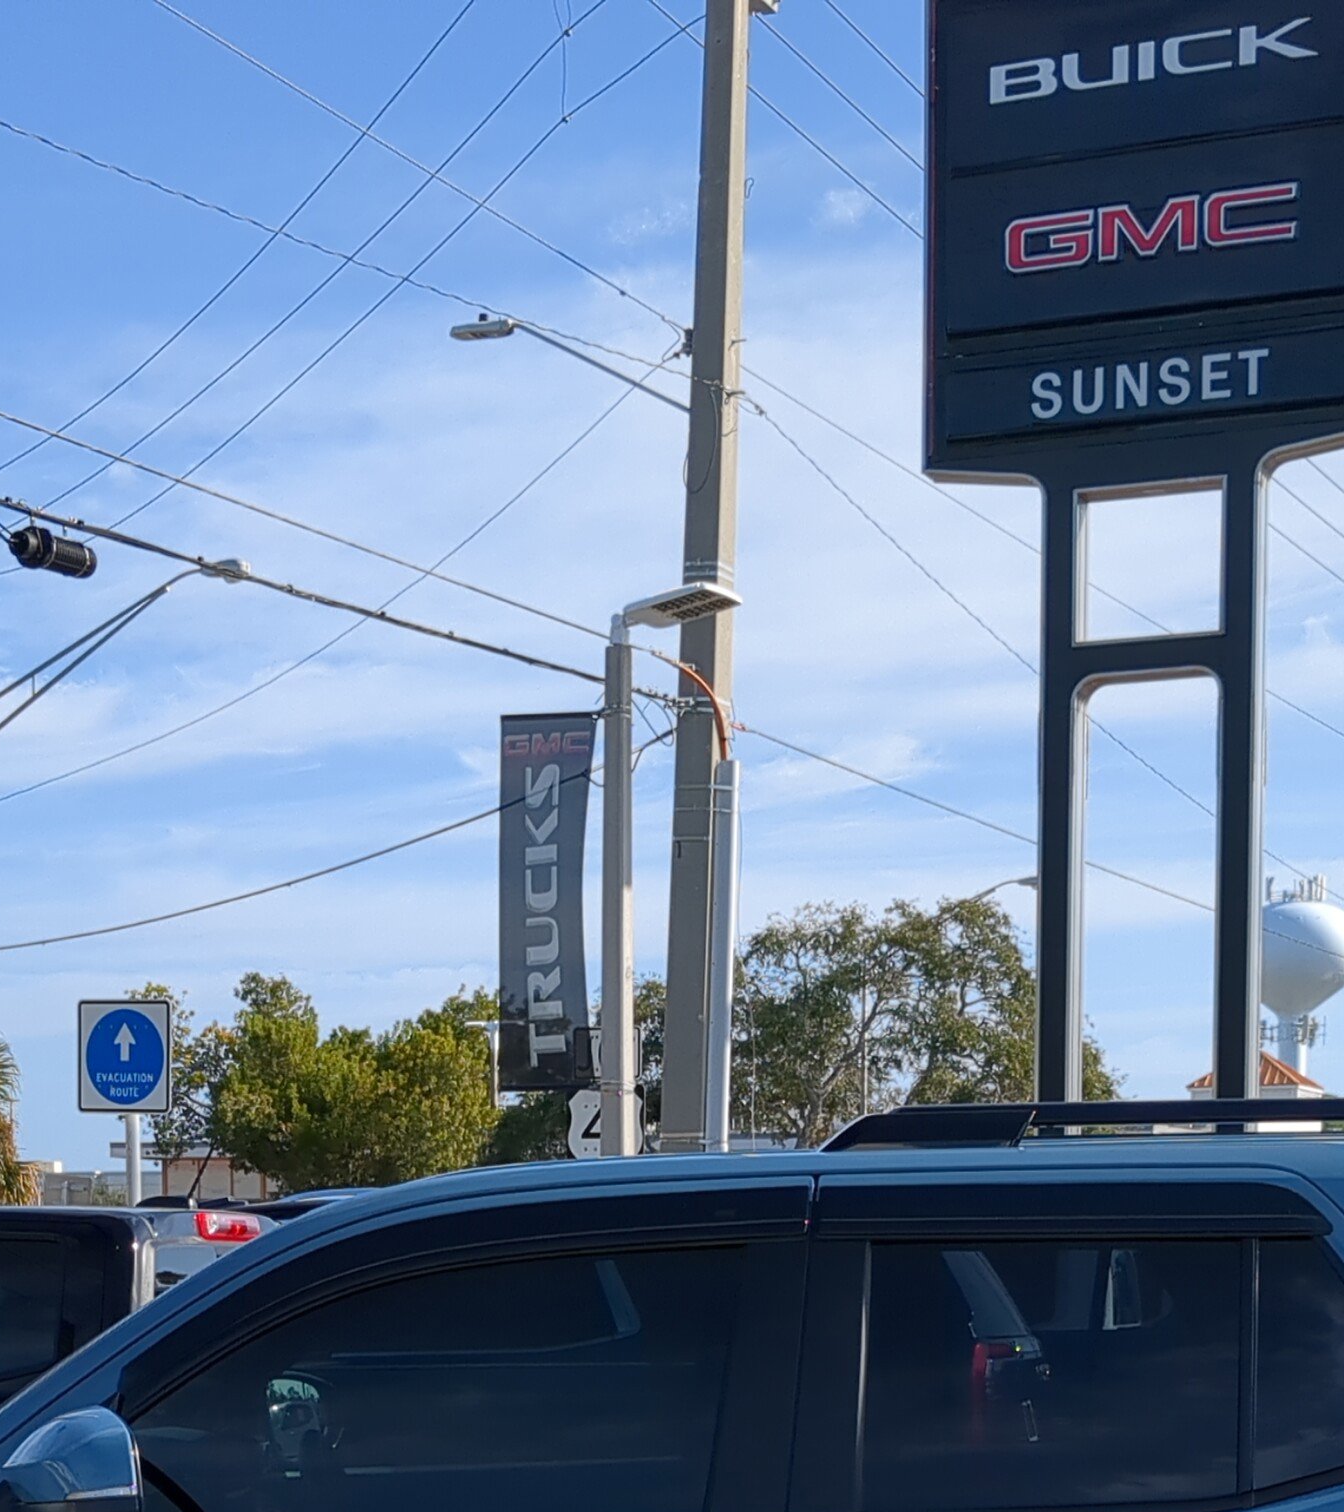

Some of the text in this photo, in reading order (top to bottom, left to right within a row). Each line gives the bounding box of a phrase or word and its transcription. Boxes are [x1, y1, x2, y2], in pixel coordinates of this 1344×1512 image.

[989, 16, 1319, 105] BUICK
[1004, 180, 1301, 273] GMC
[1030, 347, 1270, 420] SUNSET
[502, 731, 591, 756] GMC
[524, 762, 567, 1068] TRUCKS
[96, 1072, 154, 1083] EVACUATION
[109, 1085, 140, 1098] ROUTE
